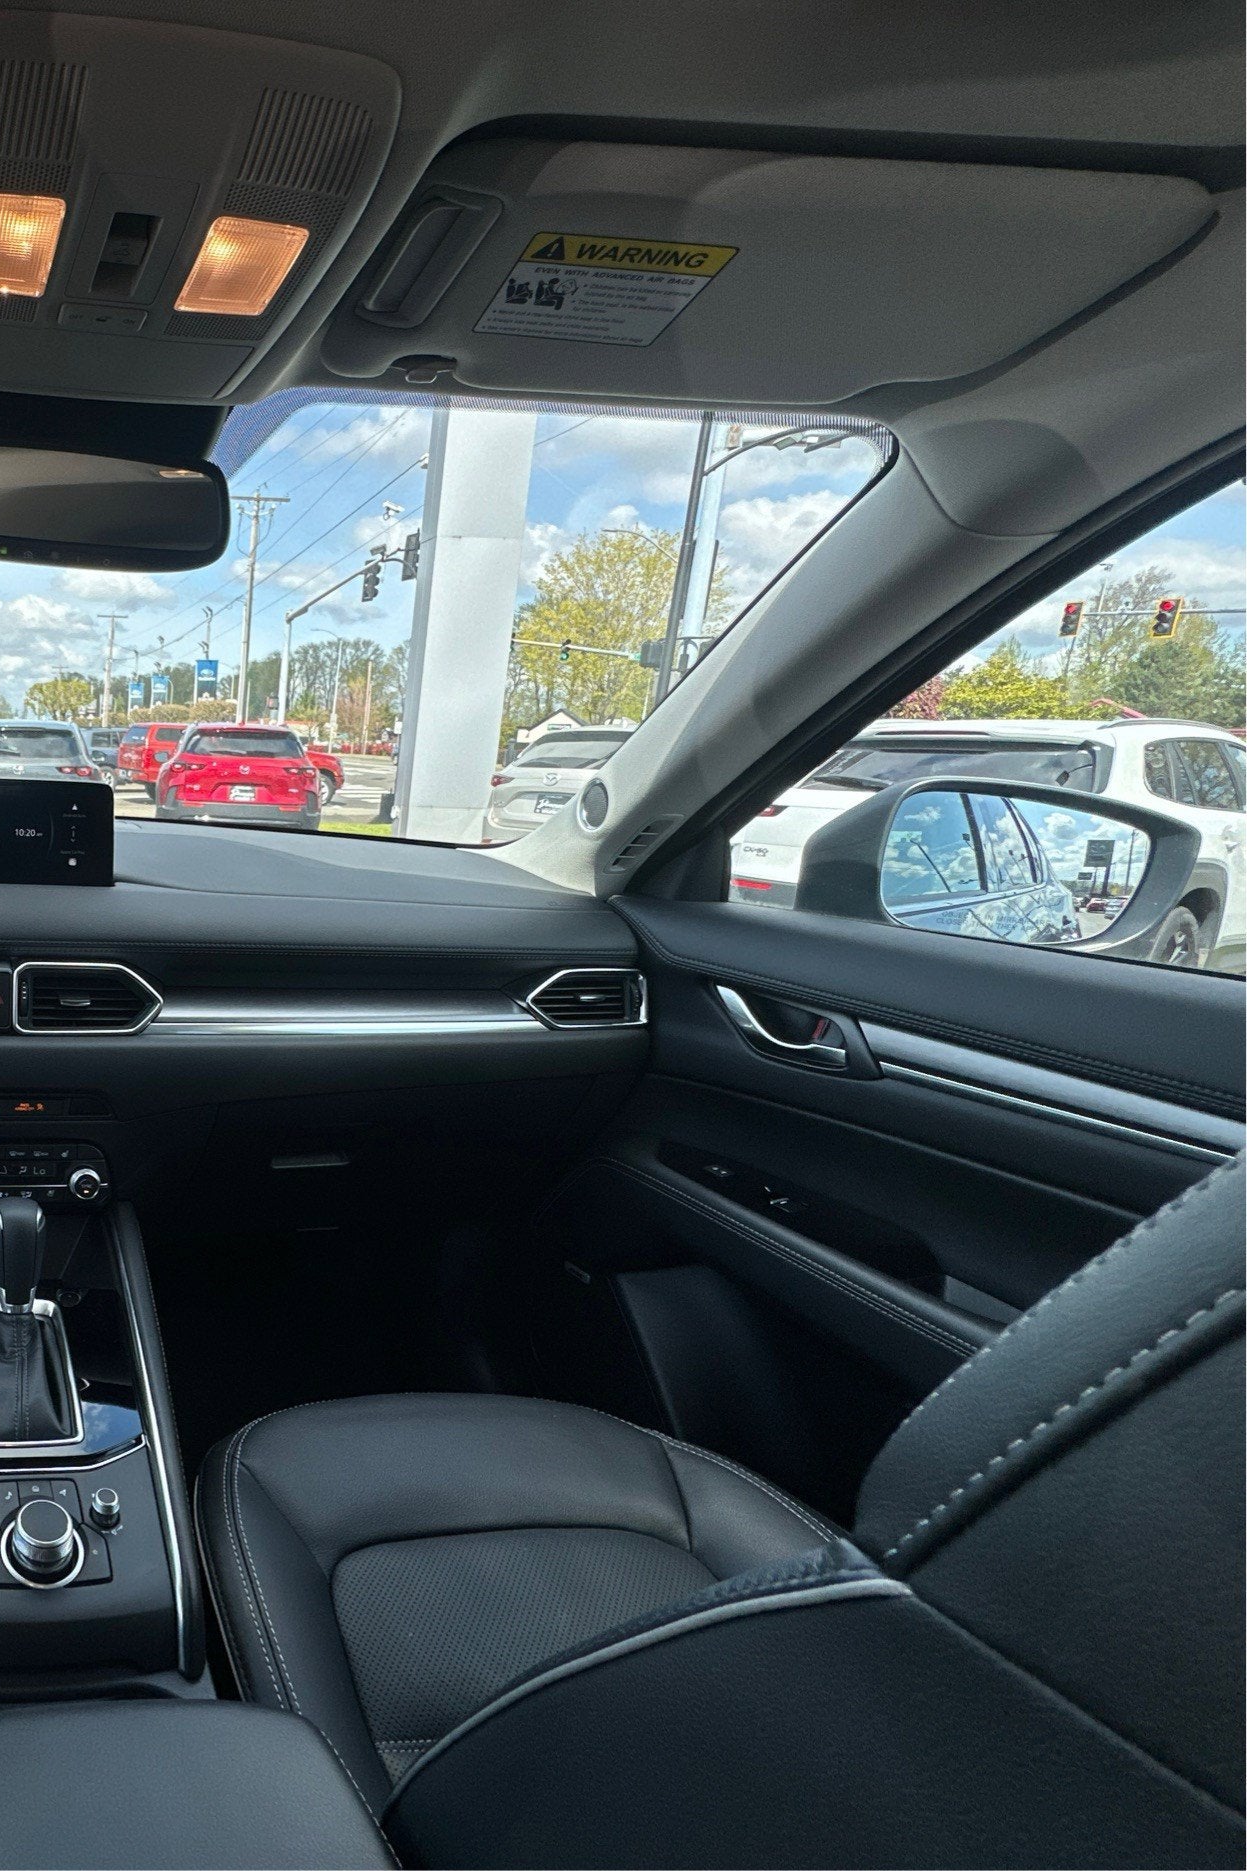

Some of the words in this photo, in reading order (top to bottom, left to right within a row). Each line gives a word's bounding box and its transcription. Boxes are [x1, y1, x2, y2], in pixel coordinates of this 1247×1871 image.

[576, 244, 709, 270] WARNING
[535, 266, 561, 275] EVEN
[564, 268, 590, 277] WITH
[592, 271, 644, 281] ADVANCED
[647, 276, 664, 284] AIR
[667, 278, 696, 286] BAGS
[15, 828, 36, 837] 10:20
